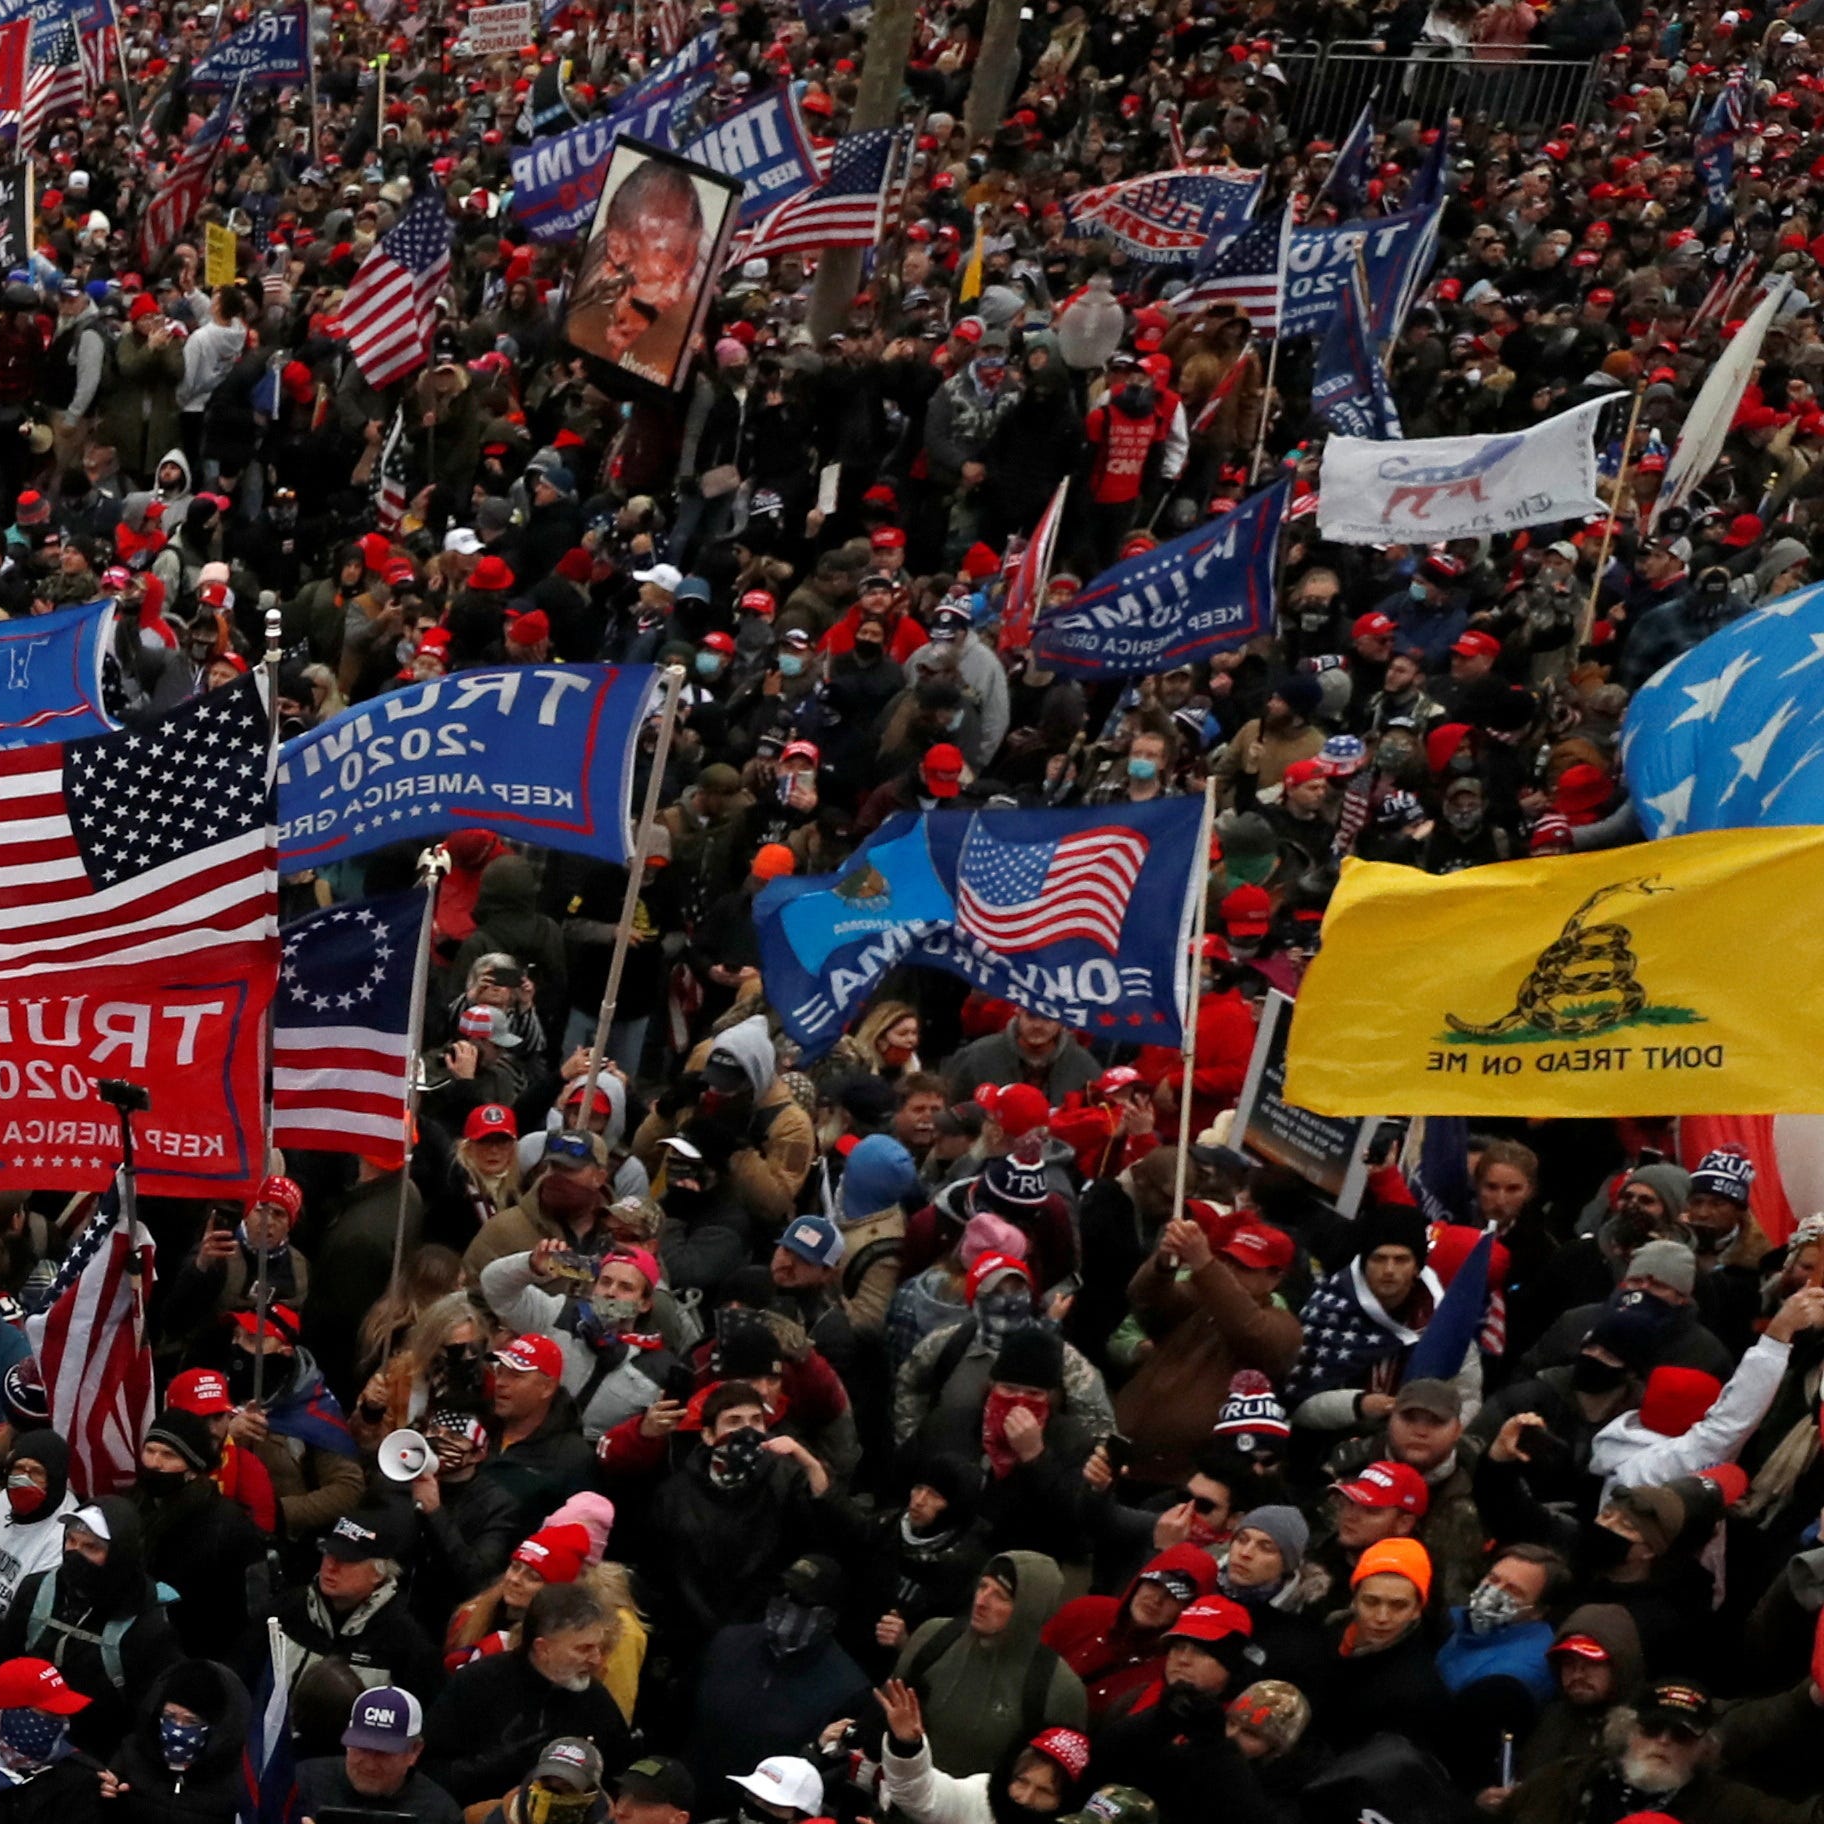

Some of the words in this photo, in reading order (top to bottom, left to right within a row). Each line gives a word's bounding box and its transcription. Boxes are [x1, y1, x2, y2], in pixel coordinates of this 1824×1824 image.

[471, 7, 529, 20] CONGRESS
[471, 35, 529, 50] COURAGE
[1697, 1151, 1756, 1181] TRUM
[1003, 1168, 1049, 1195] TRU
[364, 1707, 395, 1724] CNN
